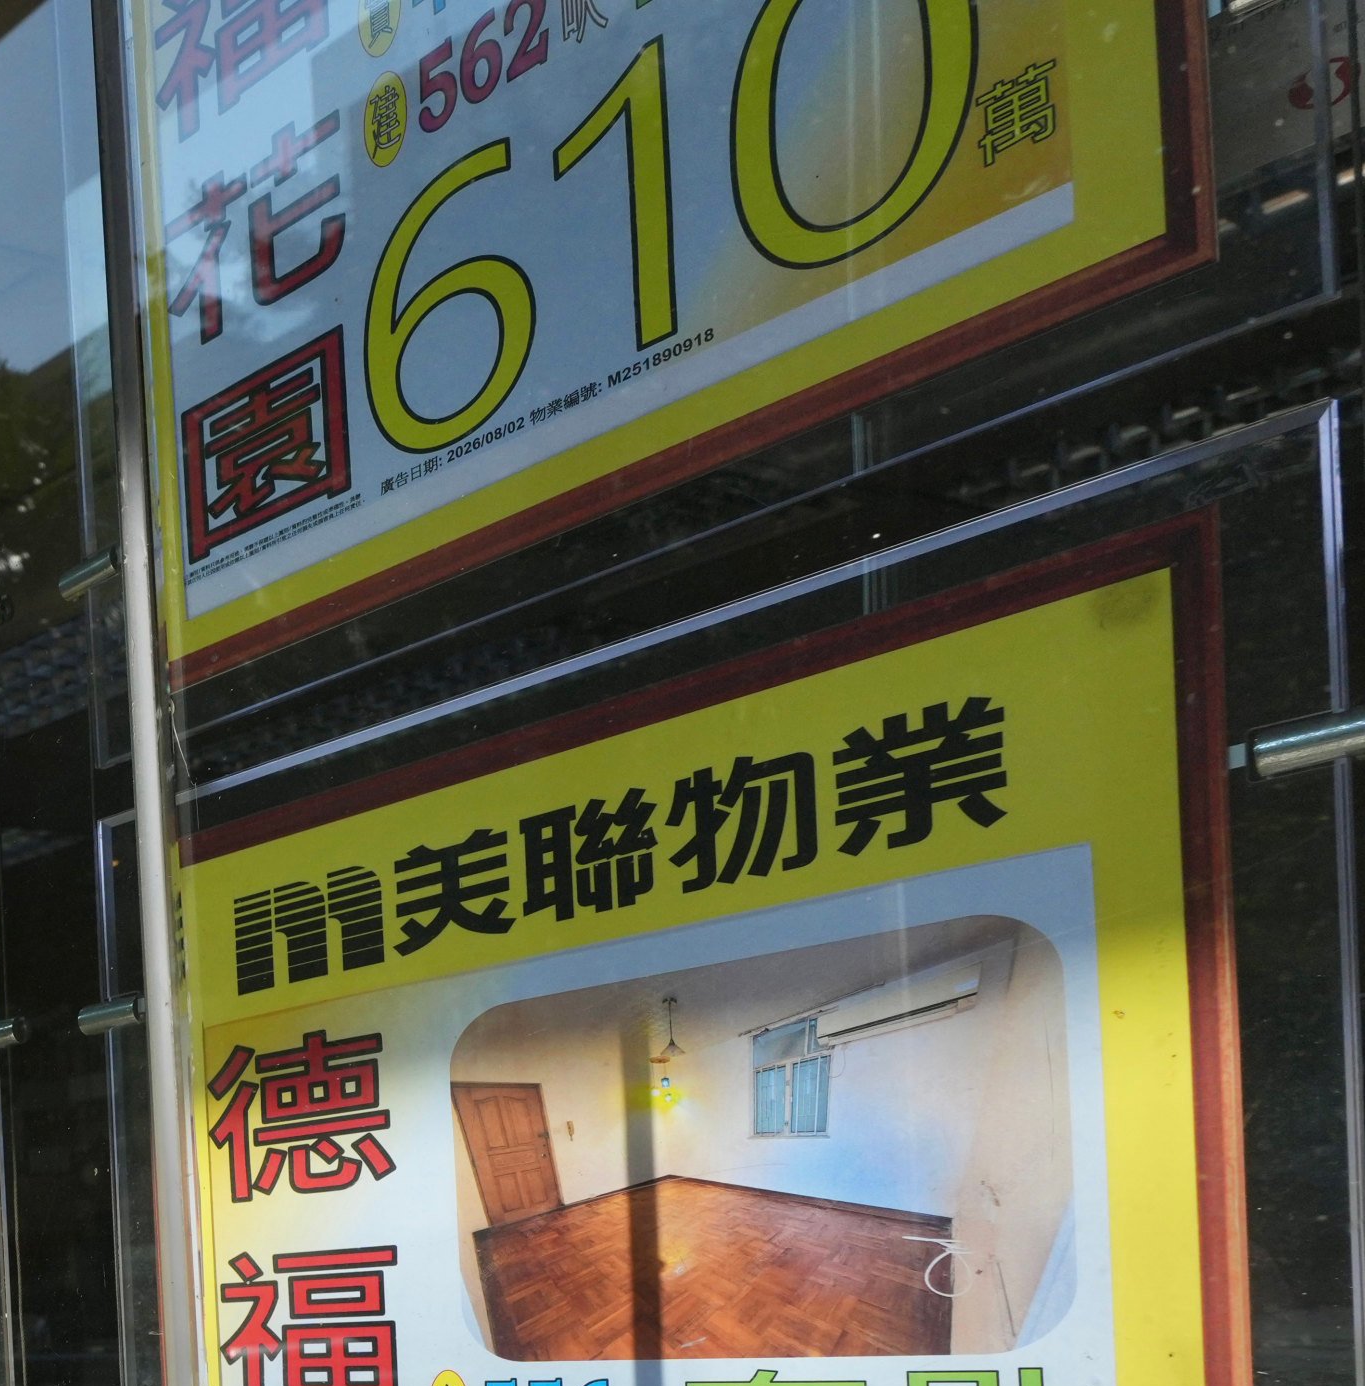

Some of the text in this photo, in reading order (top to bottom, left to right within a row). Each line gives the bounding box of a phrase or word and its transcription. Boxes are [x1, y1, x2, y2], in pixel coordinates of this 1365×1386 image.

[417, 0, 550, 134] 562
[364, 0, 1058, 453] 610 萬
[446, 416, 526, 464] 2026/08/02
[529, 381, 604, 427] 物業編號:
[607, 326, 716, 389] M251890918
[393, 696, 1010, 956] 美聯物業
